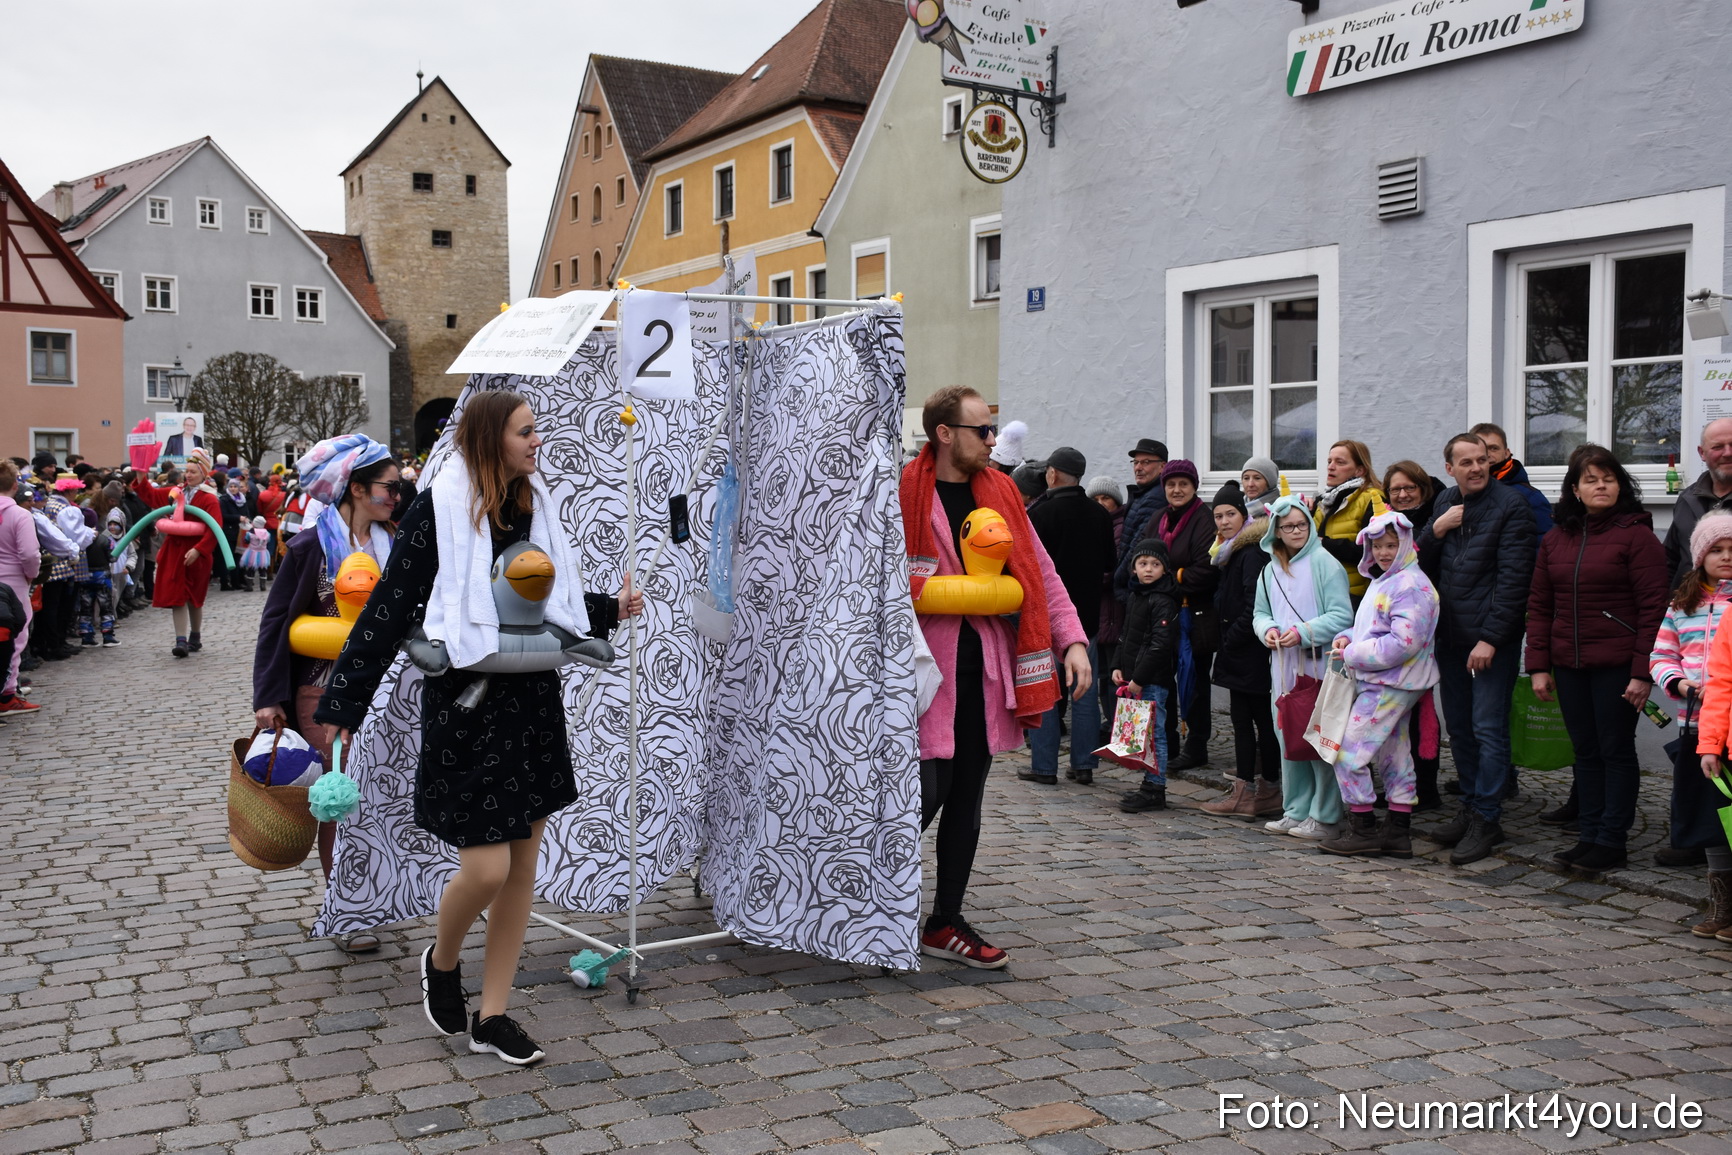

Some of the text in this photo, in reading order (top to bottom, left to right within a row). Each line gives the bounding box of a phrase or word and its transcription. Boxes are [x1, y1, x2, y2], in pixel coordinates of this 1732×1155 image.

[982, 4, 1011, 22] Café
[1341, 11, 1396, 35] Pizzeria
[1411, 0, 1444, 16] Cafe
[966, 22, 1023, 45] Eisdiele
[1329, 13, 1522, 79] Bella Roma
[949, 65, 992, 80] Roma
[976, 59, 1015, 74] Bella
[984, 108, 1007, 119] WINKLER
[979, 161, 1009, 174] BERCHING
[1031, 289, 1040, 302] 19
[689, 310, 705, 319] de
[696, 326, 717, 334] Wir
[635, 319, 675, 378] 2
[1703, 369, 1732, 380] Bel
[1017, 661, 1053, 677] Sauna
